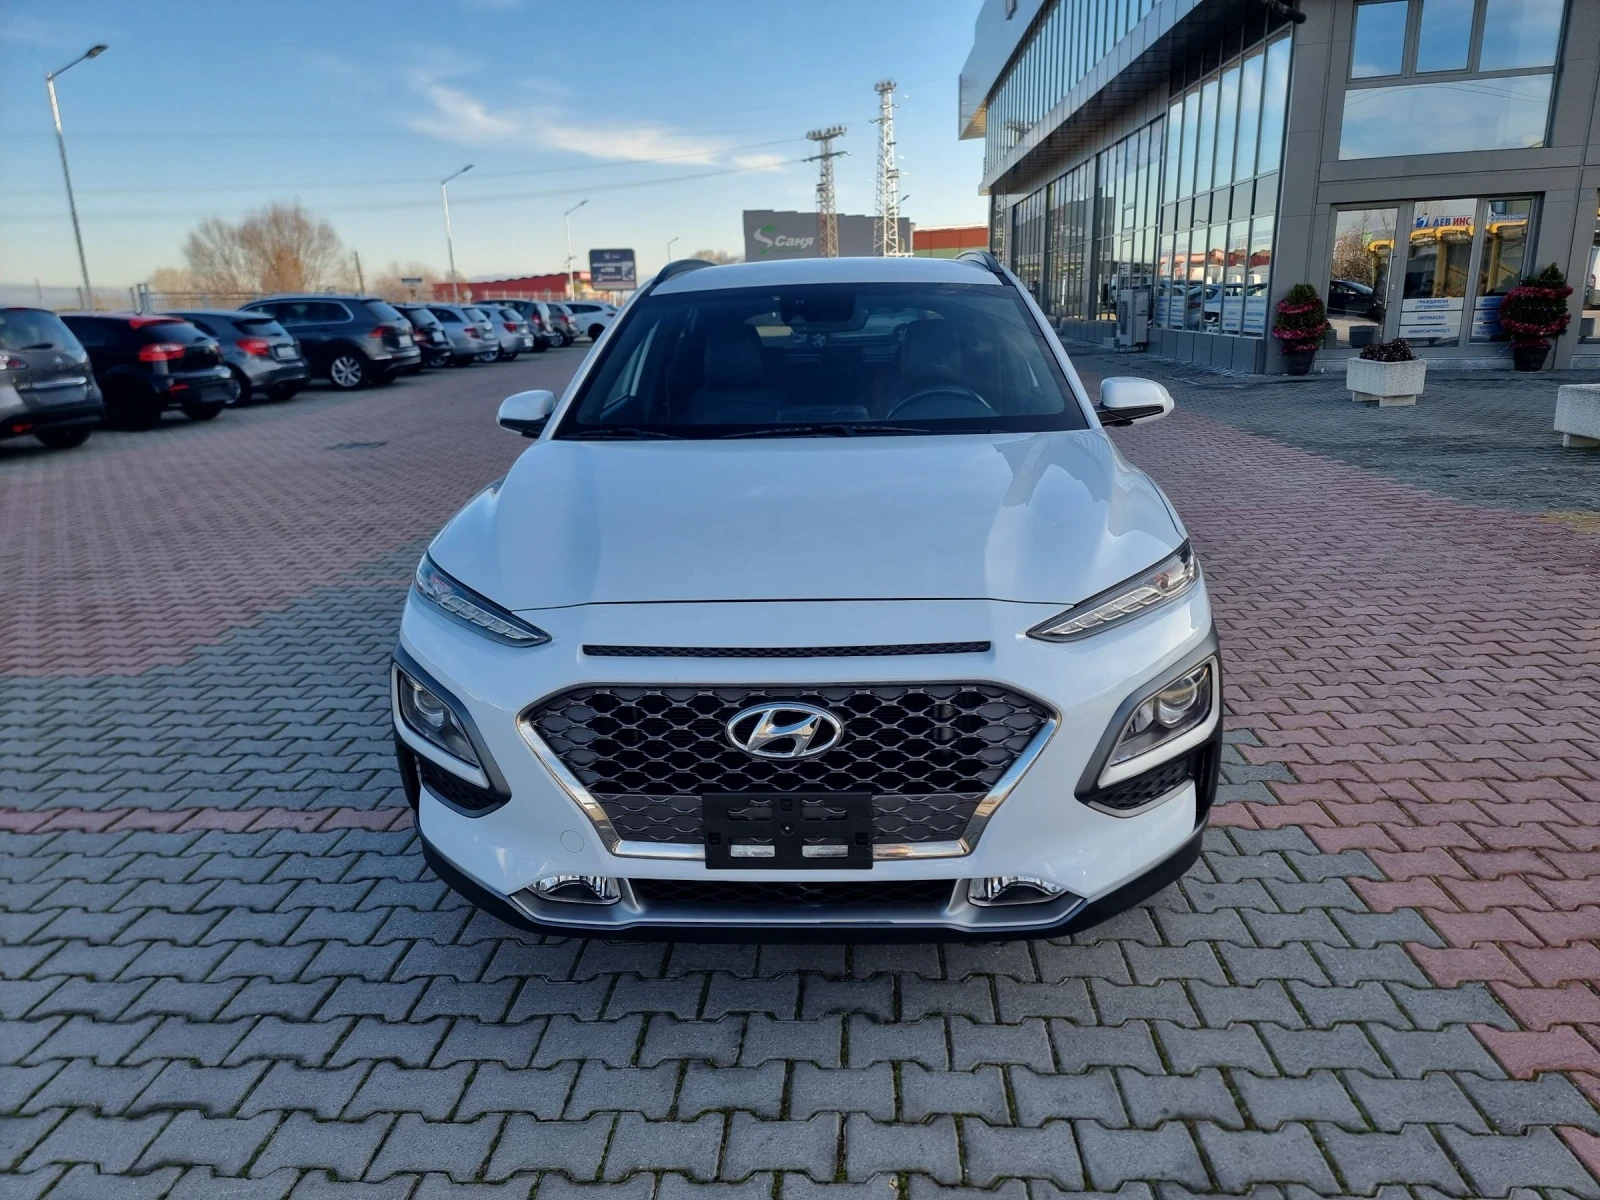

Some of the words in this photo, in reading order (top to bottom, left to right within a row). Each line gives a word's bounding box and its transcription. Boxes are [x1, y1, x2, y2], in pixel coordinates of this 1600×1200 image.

[1433, 217, 1451, 227] ЛЕВ
[1452, 216, 1472, 226] ИНС
[774, 235, 815, 249] Саня
